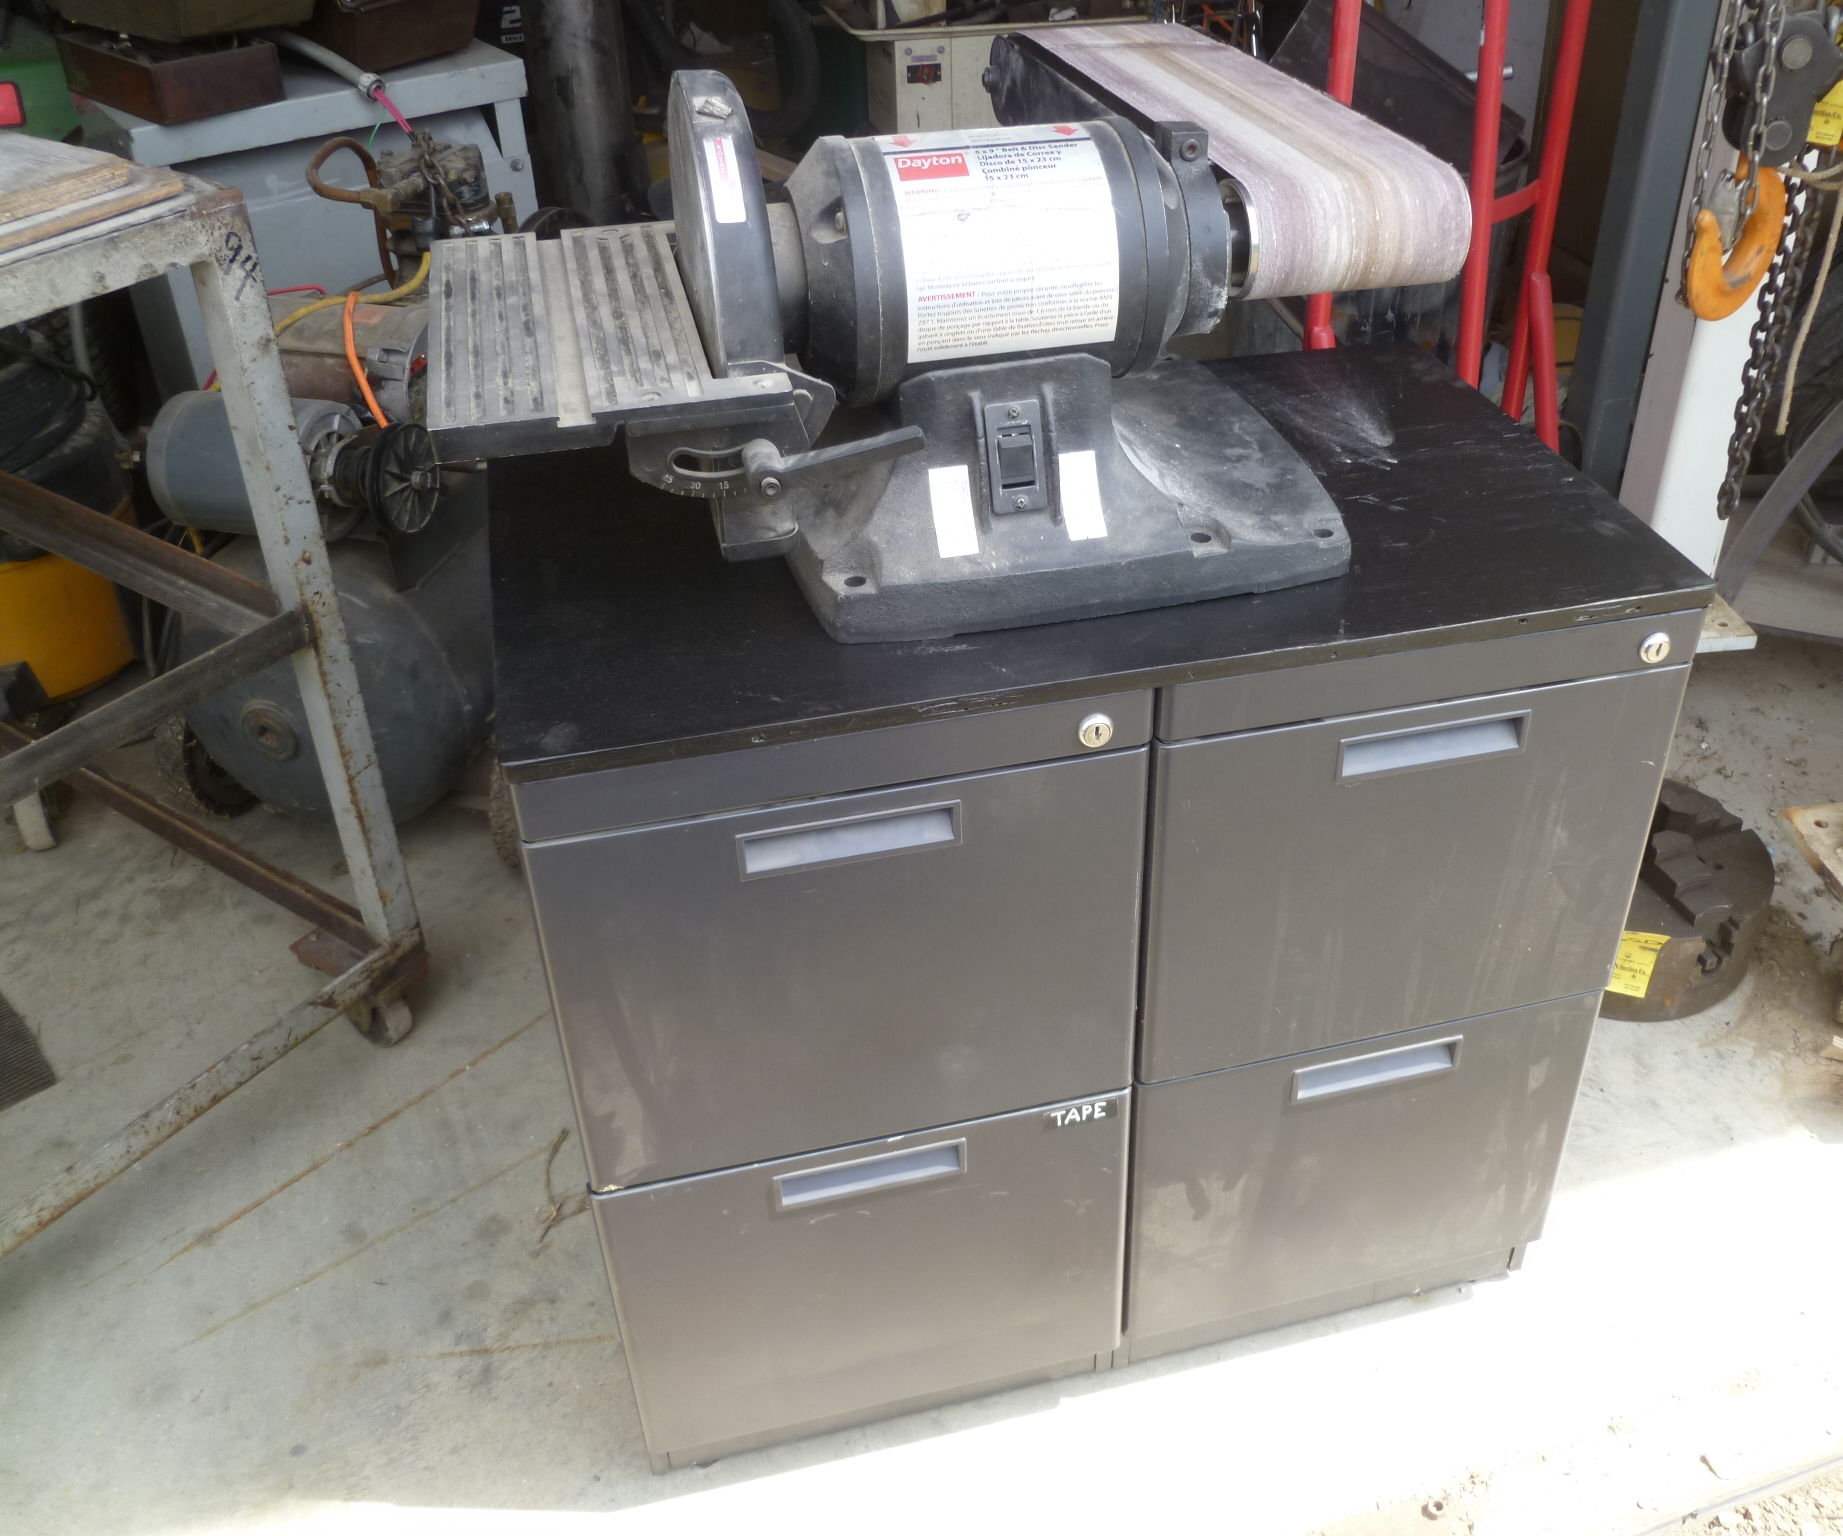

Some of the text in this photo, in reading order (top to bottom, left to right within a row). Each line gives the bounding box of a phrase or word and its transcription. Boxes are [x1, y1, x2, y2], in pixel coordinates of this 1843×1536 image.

[1048, 141, 1078, 149] Sander
[977, 151, 1013, 162] Lijadora
[1026, 149, 1055, 157] Correa
[897, 154, 963, 170] Dayton
[979, 159, 1003, 167] Disco
[1022, 164, 1056, 172] ponceur
[225, 231, 259, 301] 94
[917, 291, 976, 302] AVERTISSEMENT
[719, 481, 730, 490] 15
[1050, 1101, 1107, 1127] TAPE
